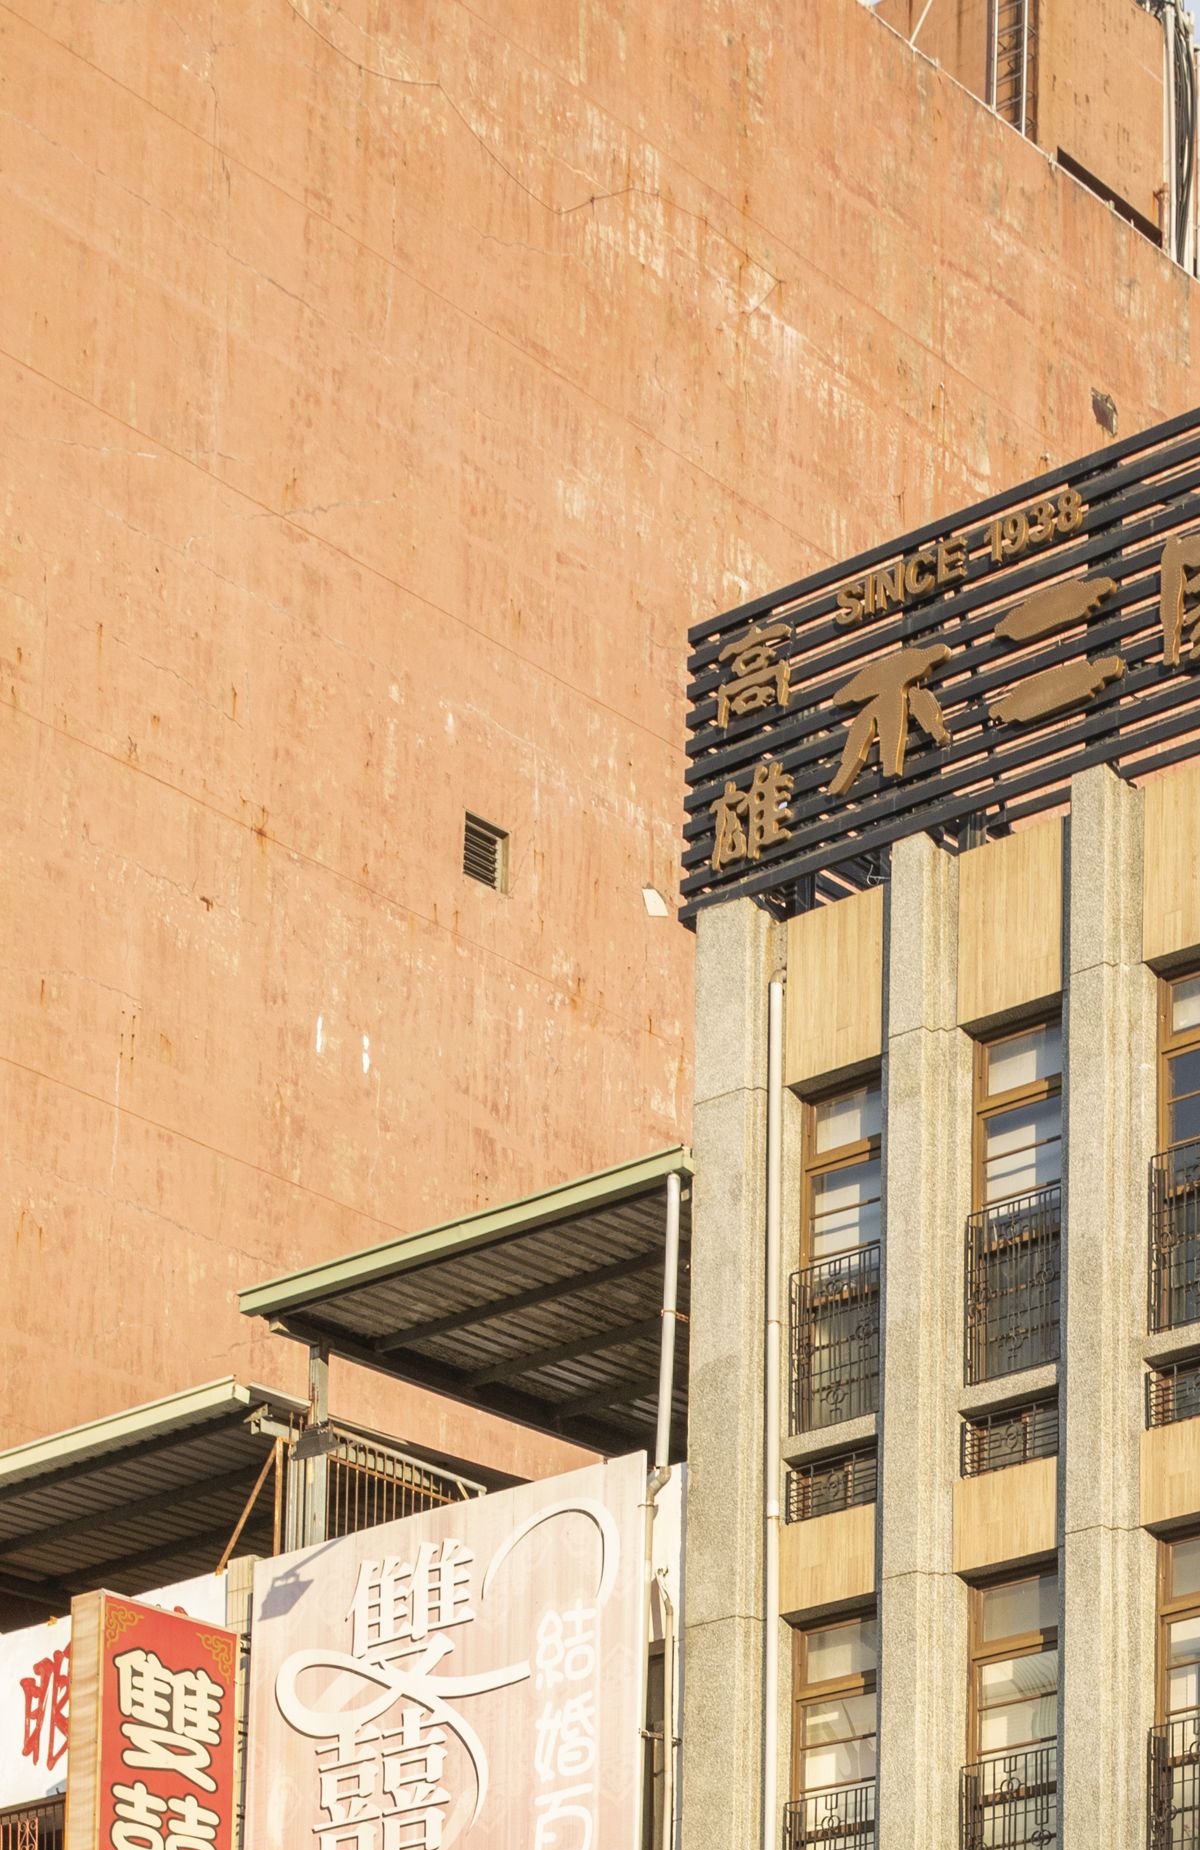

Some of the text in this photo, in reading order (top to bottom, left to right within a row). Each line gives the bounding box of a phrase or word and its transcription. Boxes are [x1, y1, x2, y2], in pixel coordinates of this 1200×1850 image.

[835, 487, 1085, 628] SINCE 1938
[709, 621, 795, 873] 高雄
